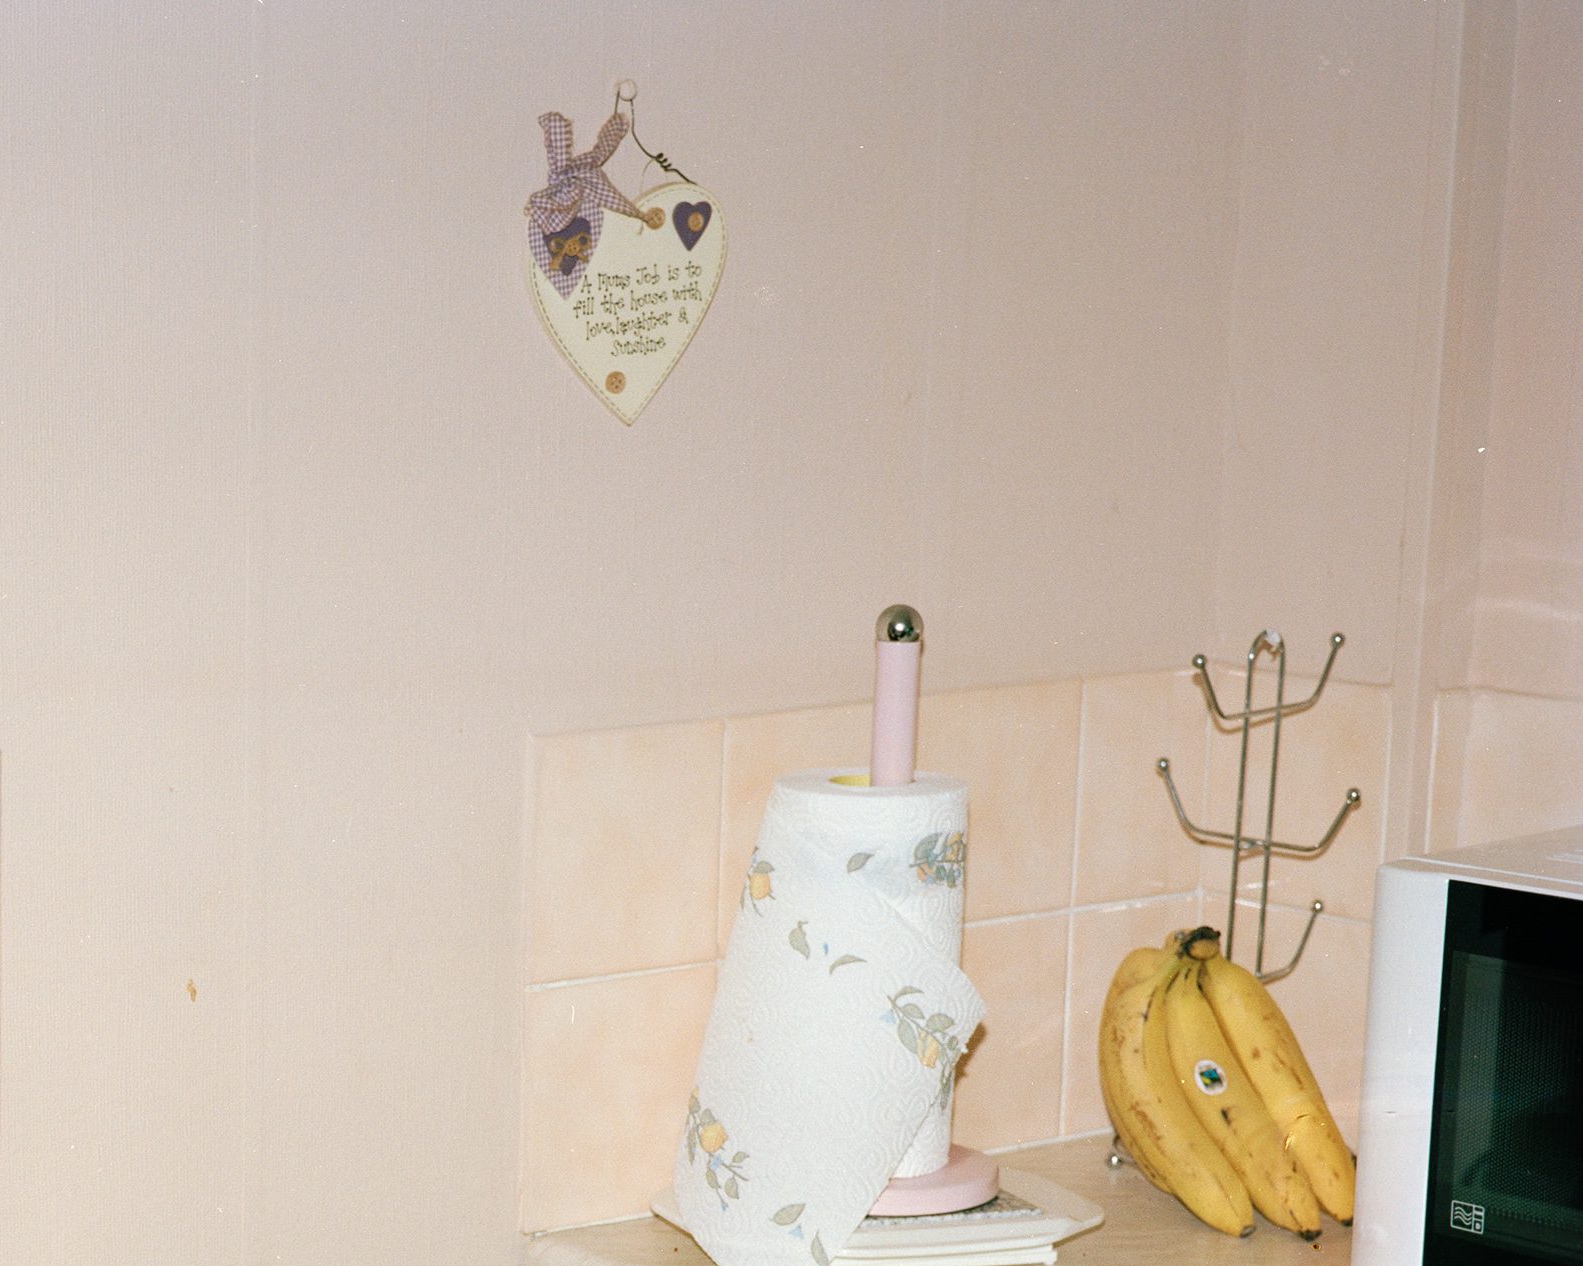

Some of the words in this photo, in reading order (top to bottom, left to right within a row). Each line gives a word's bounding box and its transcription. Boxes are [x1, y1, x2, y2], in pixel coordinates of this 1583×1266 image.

[580, 274, 593, 294] A
[635, 263, 661, 286] Job
[667, 264, 680, 281] is
[685, 260, 702, 279] to
[573, 296, 595, 319] fill
[600, 292, 626, 316] the
[630, 290, 668, 311] house
[671, 281, 703, 302] with
[678, 306, 690, 324] &
